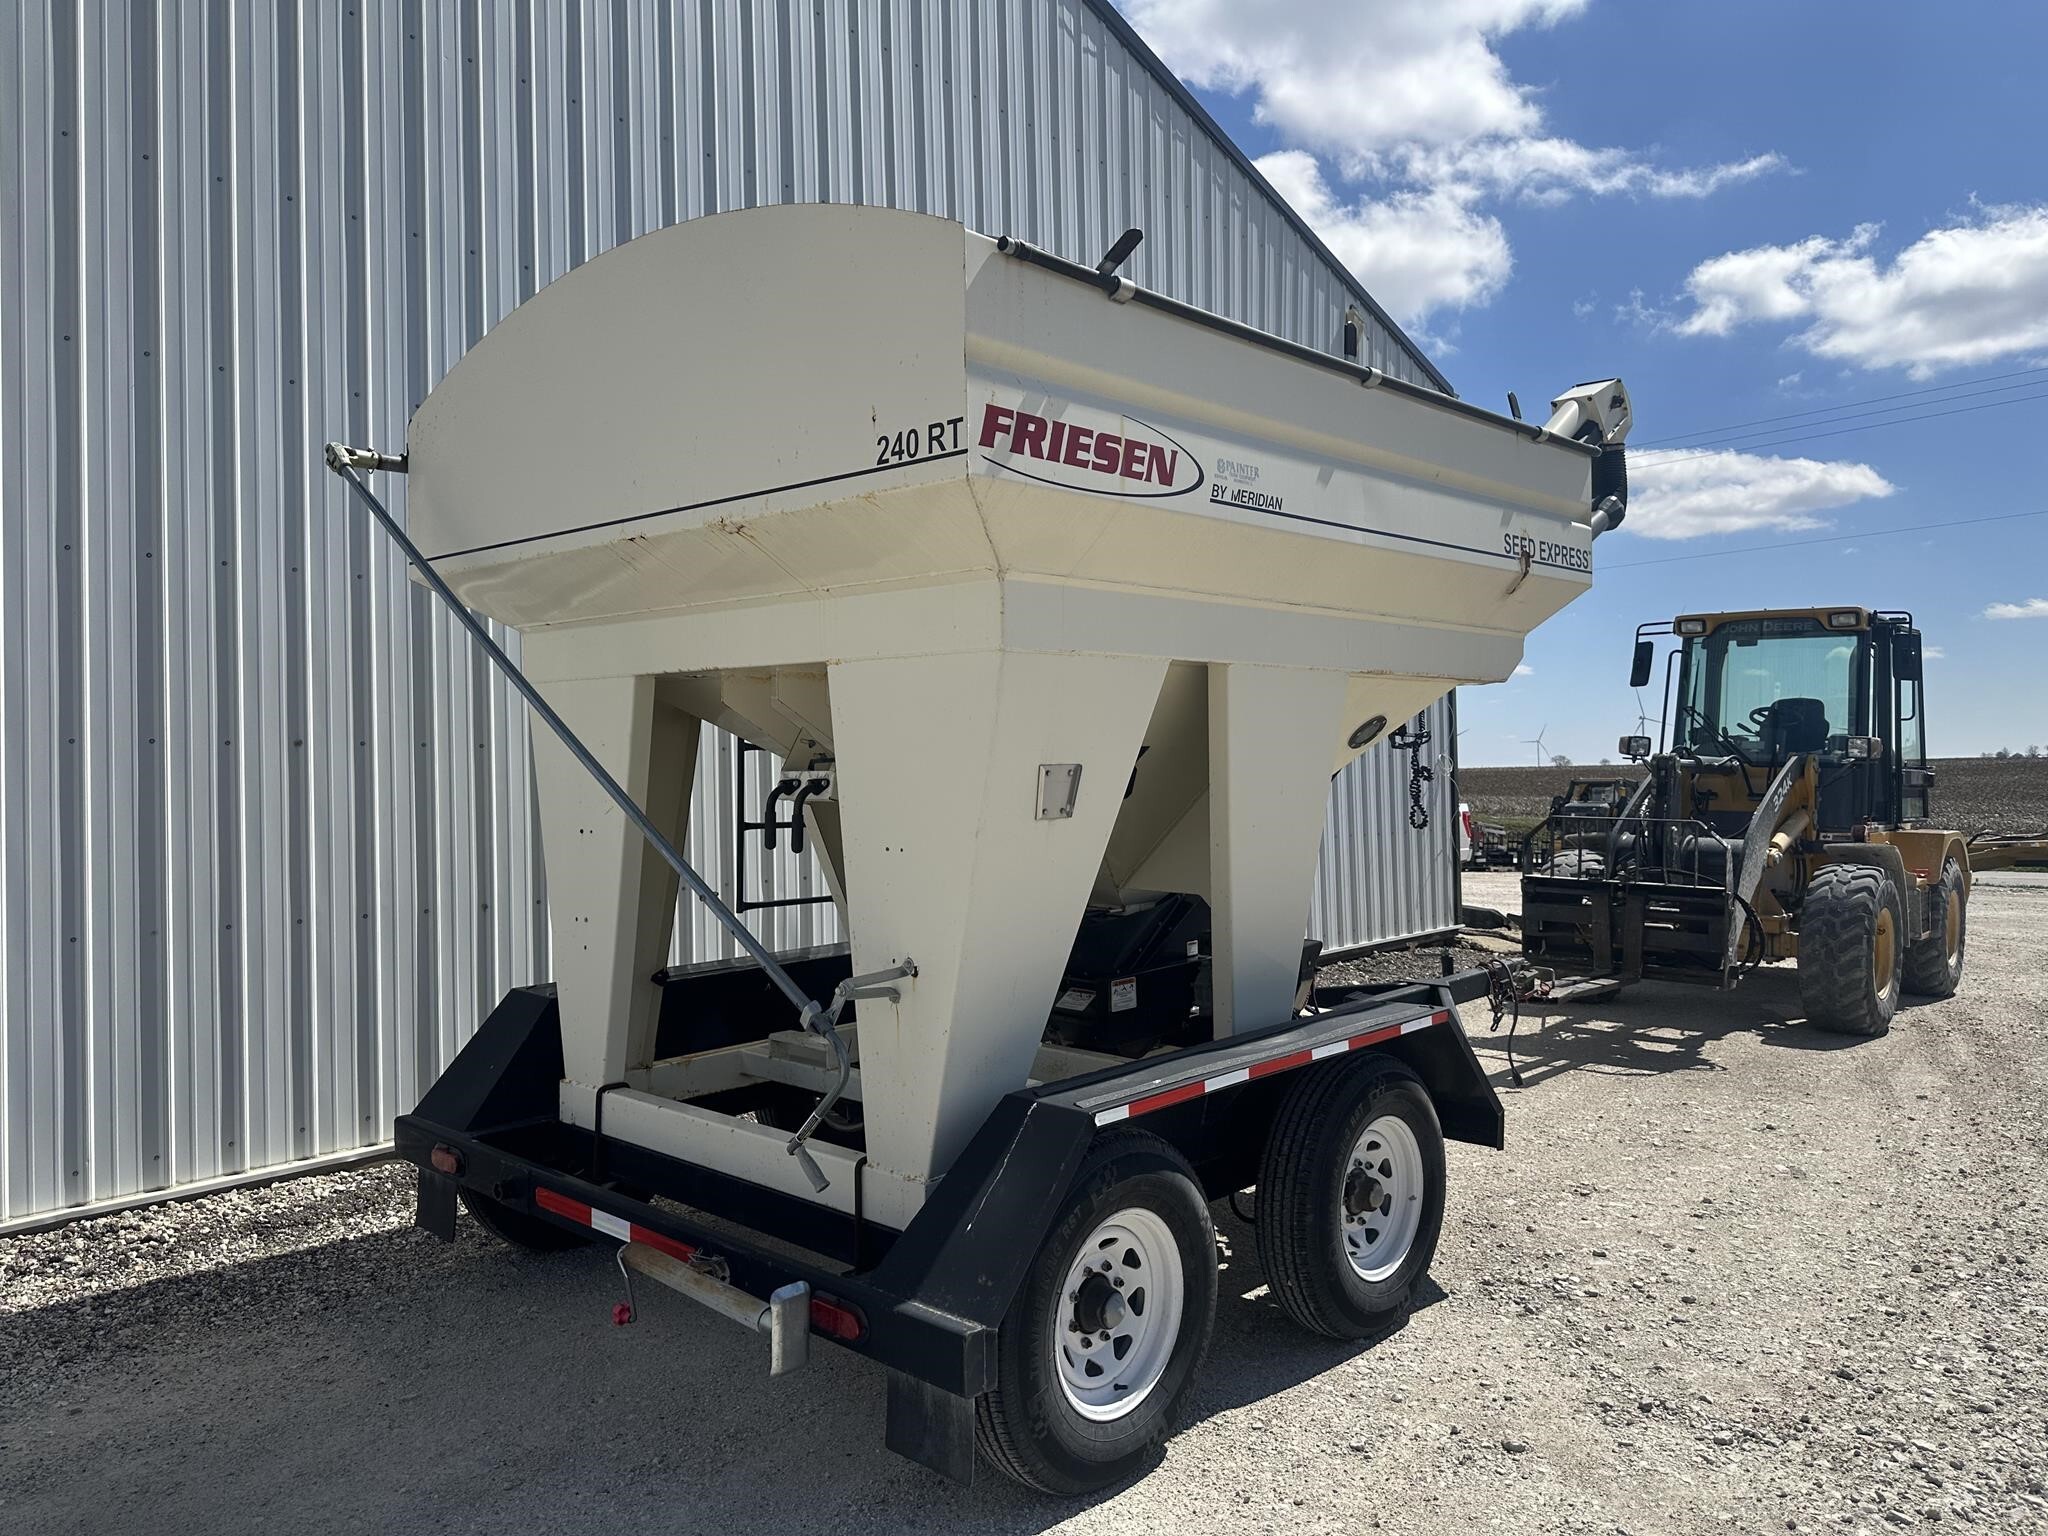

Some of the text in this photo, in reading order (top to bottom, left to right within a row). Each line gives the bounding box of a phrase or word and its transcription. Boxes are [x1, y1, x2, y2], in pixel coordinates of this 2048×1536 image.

[876, 416, 964, 466] 240 RT
[978, 403, 1178, 487] FRIESEN
[1226, 459, 1260, 479] PAINTER
[1211, 483, 1283, 511] BY MERIDIAN
[1504, 532, 1589, 570] SEED EXPRESS
[1720, 619, 1814, 635] JOHN DEERE
[1773, 772, 1793, 813] 324K
